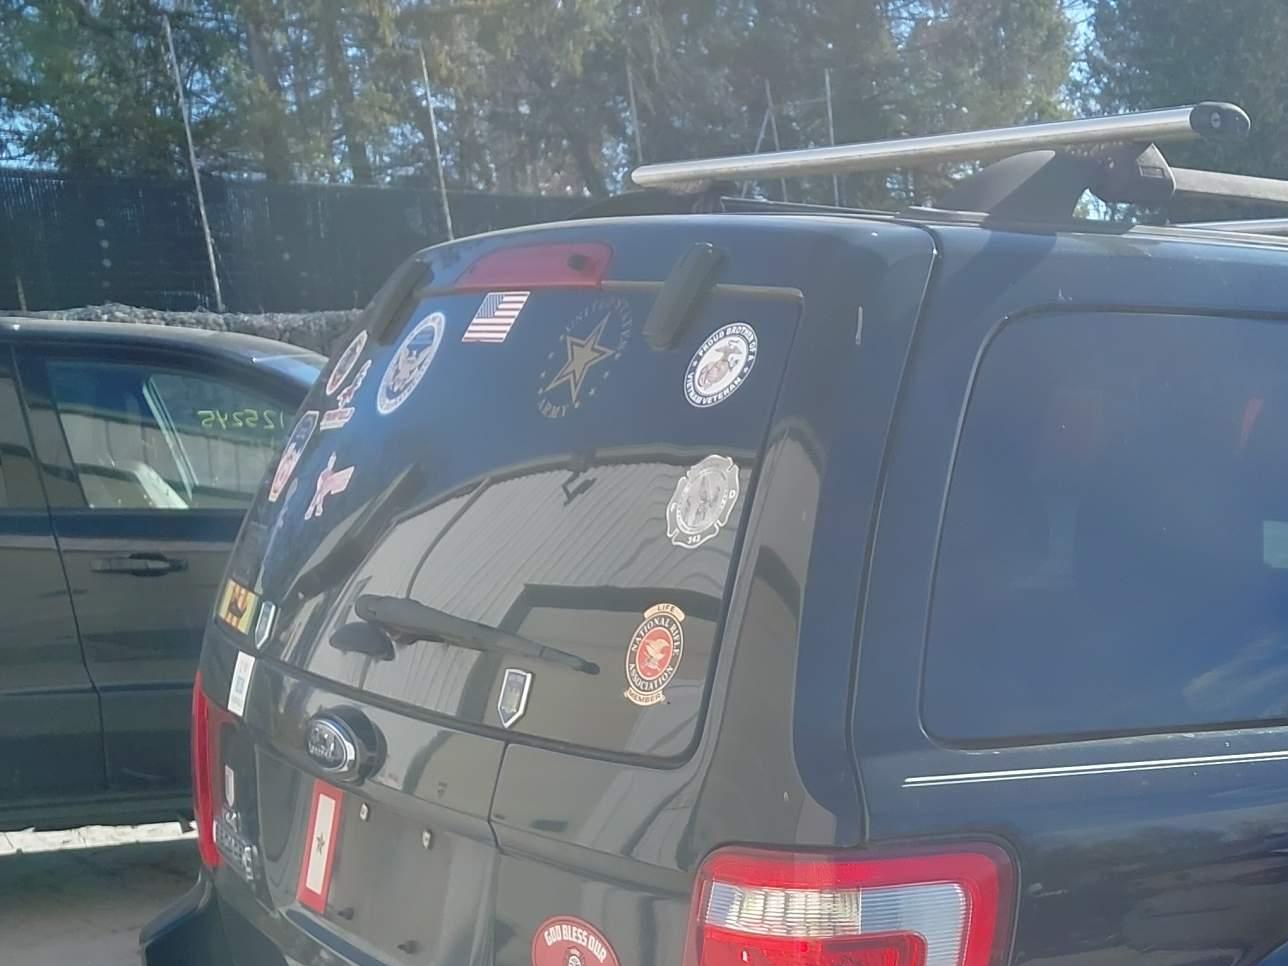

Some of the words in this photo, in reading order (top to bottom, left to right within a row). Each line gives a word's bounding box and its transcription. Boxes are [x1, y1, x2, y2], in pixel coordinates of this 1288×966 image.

[698, 330, 725, 357] PROUD
[725, 325, 754, 343] BROTHER
[702, 376, 742, 405] VETERAN
[657, 604, 675, 612] LIFE
[631, 617, 670, 652] NATIONAL
[670, 623, 681, 657] RIFLE
[629, 663, 674, 691] ASSOCIATION
[628, 688, 663, 703] MEMBER
[544, 925, 562, 946] GOD
[562, 925, 588, 947] BLESS
[588, 935, 607, 964] OUR
